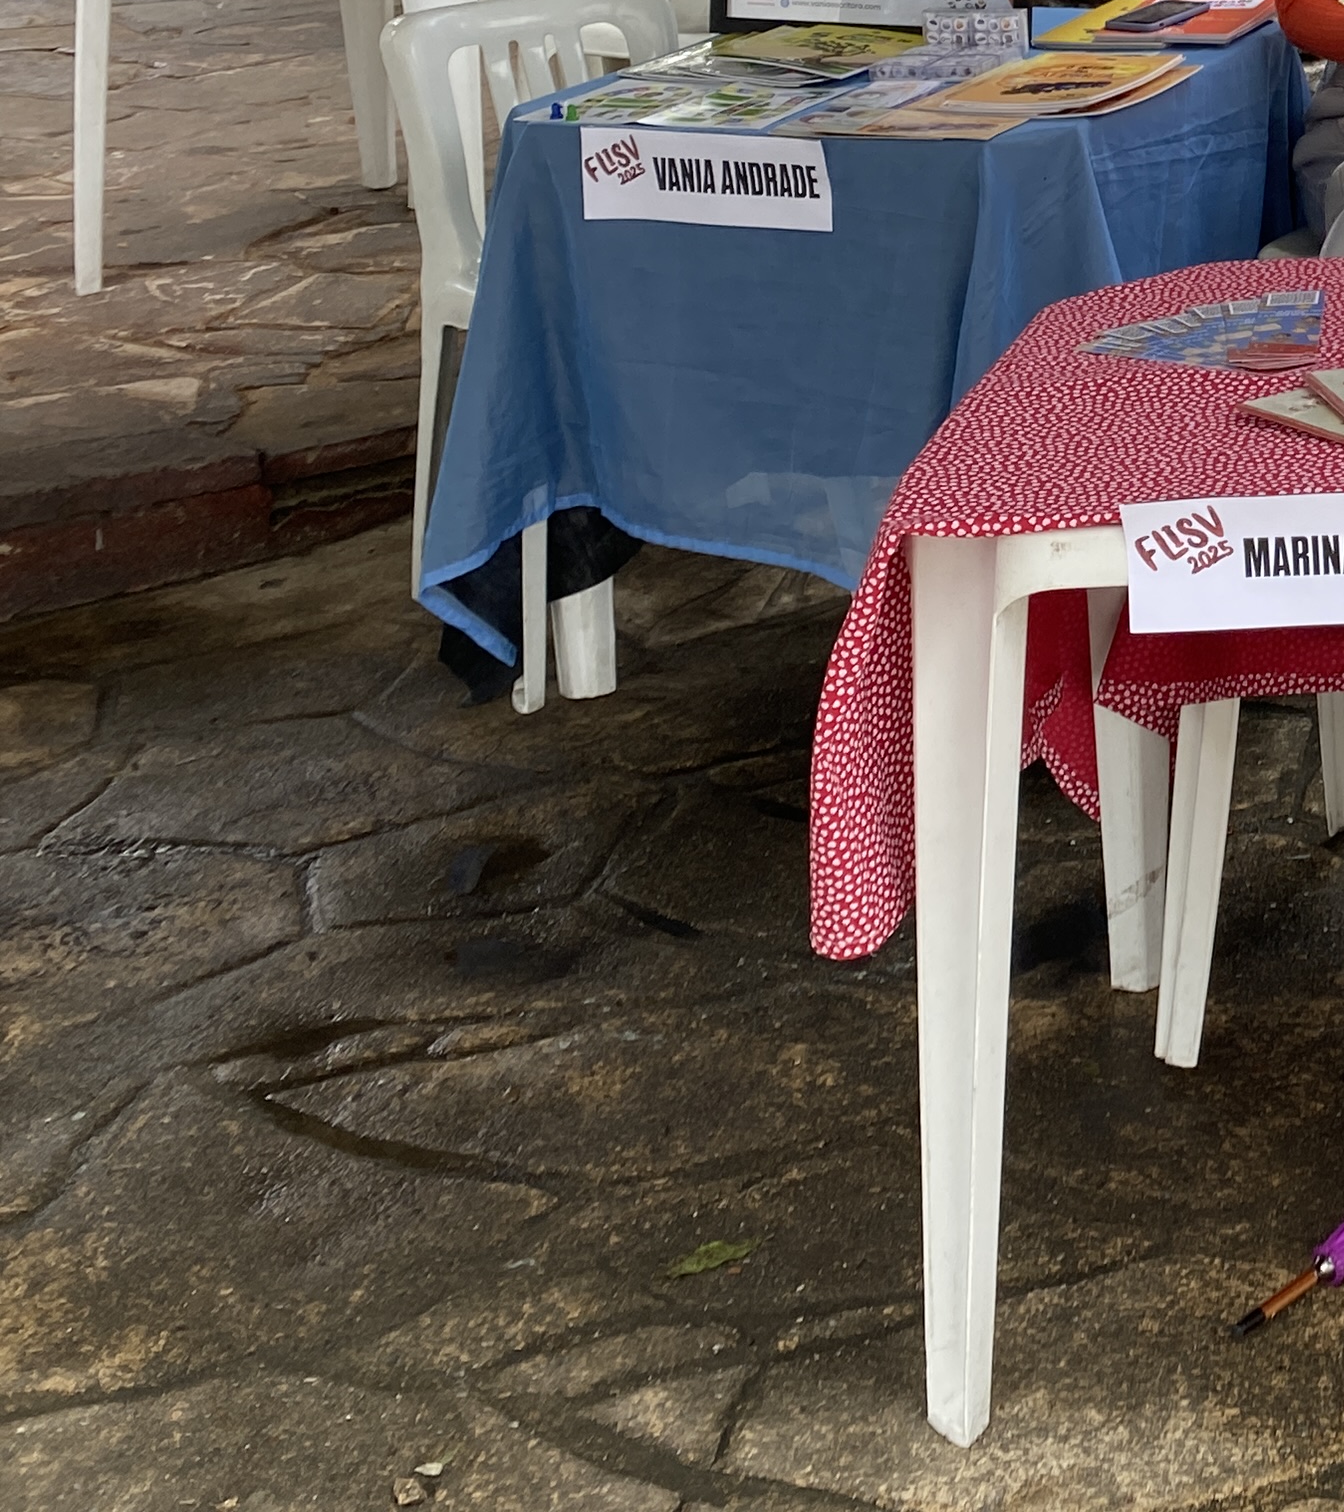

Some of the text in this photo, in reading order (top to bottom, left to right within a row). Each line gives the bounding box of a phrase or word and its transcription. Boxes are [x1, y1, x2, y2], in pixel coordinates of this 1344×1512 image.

[583, 134, 820, 199] FLISV VANIA ANDRADE
[617, 162, 646, 186] 2025
[1134, 504, 1225, 572] FLISV
[1187, 539, 1235, 576] 2025
